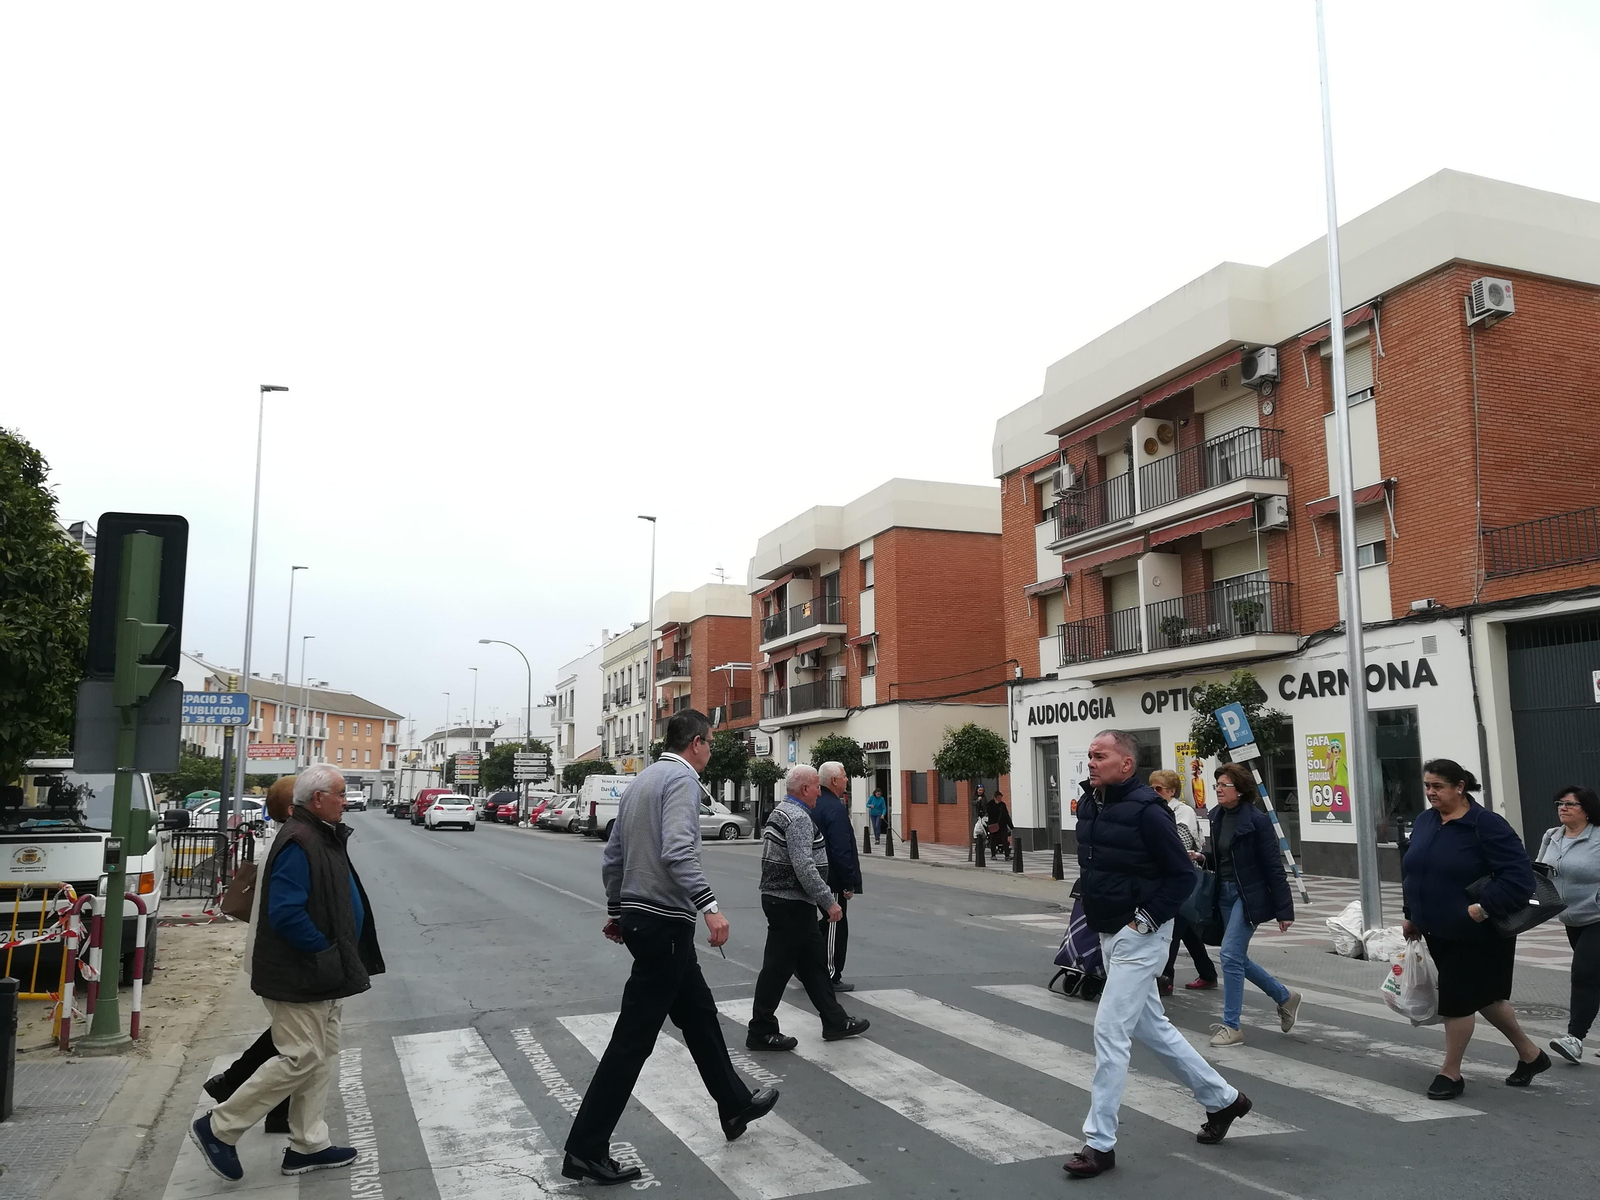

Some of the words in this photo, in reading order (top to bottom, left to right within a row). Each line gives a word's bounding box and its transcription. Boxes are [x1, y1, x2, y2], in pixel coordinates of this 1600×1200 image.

[220, 695, 233, 704] ES
[182, 706, 245, 715] PUBLICIDAD
[1028, 697, 1116, 726] AUDIOLOGIA
[1221, 710, 1240, 742] P
[1306, 736, 1330, 746] GAFA
[1177, 744, 1190, 752] gafa
[1307, 749, 1314, 757] DE
[1308, 760, 1326, 769] SOL
[1309, 772, 1331, 781] GRADUADA
